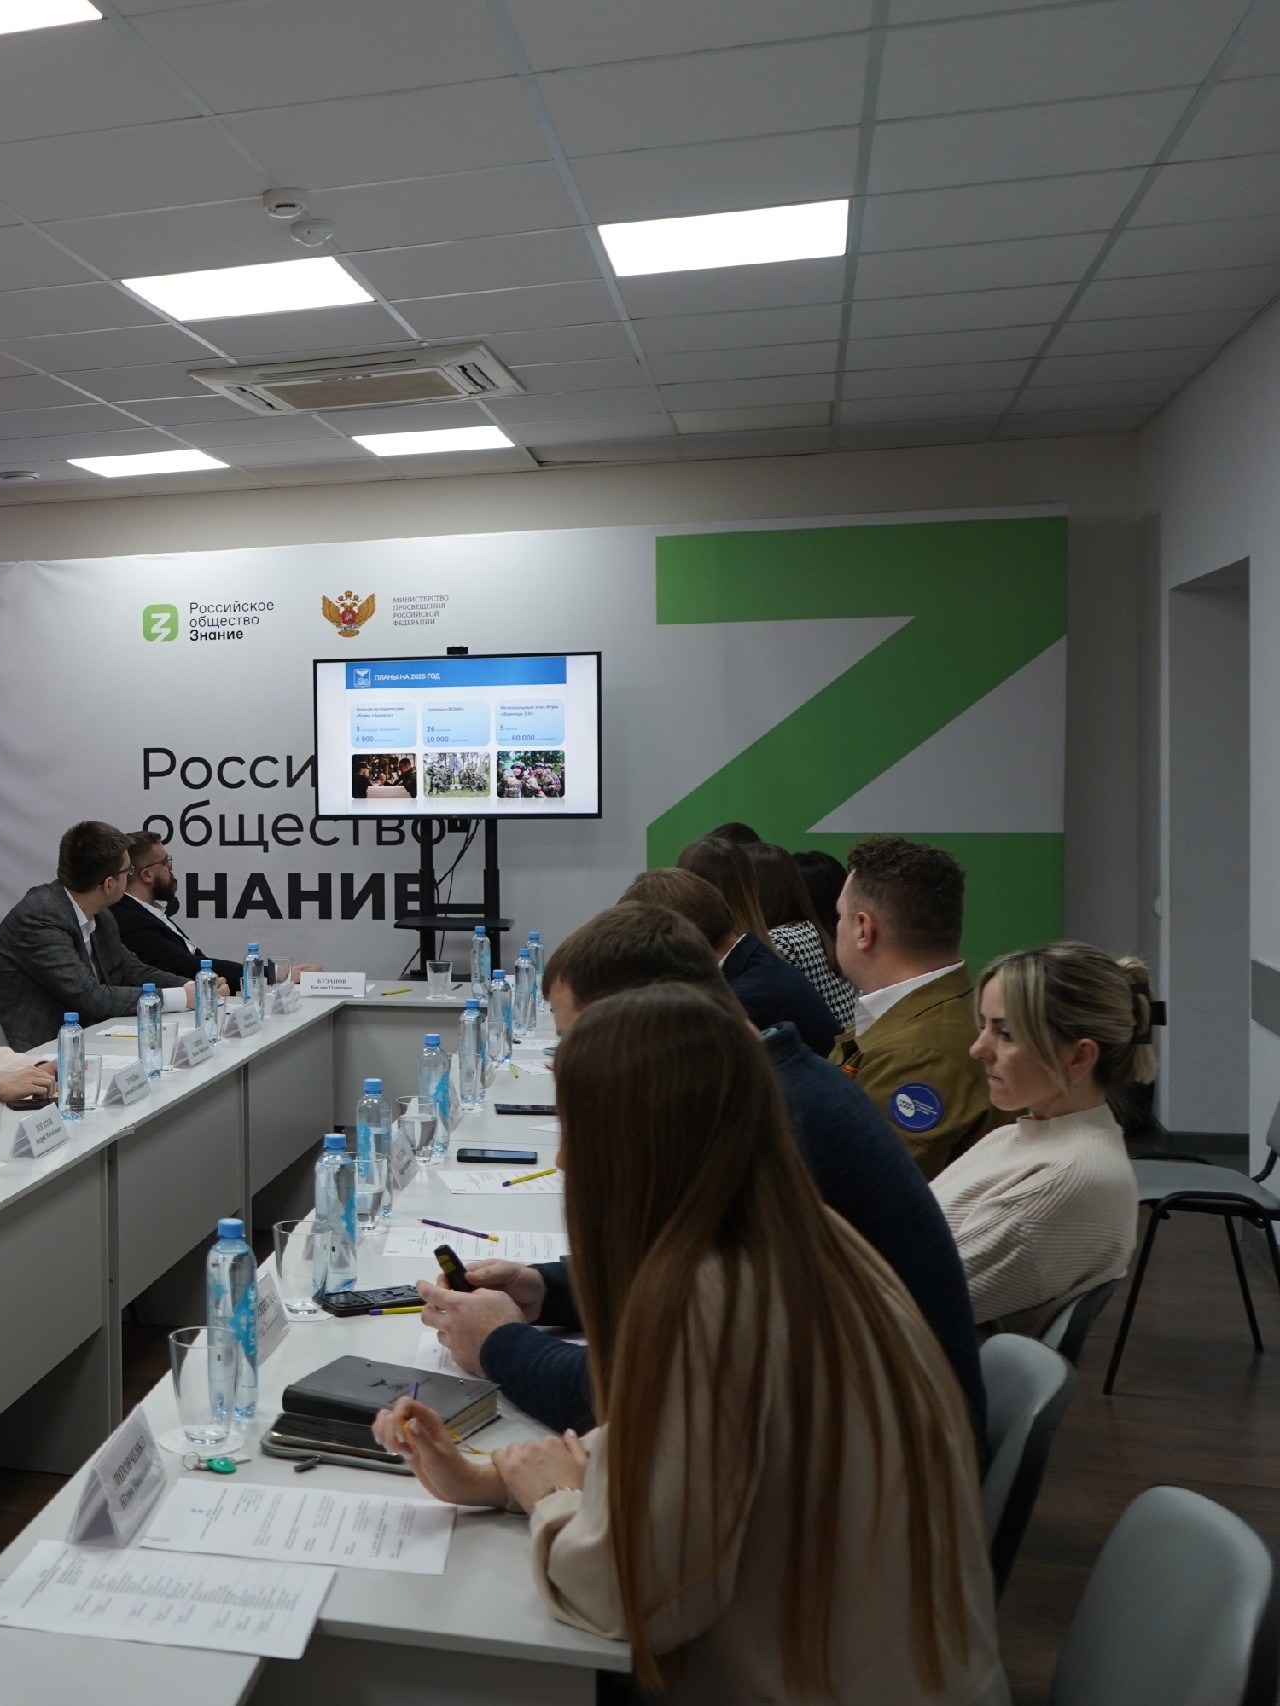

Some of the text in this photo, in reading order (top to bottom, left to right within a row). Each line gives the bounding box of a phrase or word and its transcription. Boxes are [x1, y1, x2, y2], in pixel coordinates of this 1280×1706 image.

[392, 594, 450, 603] МИНИСТЕРСТВО
[189, 600, 275, 615] Российское
[392, 602, 447, 612] ПРОСВЕЩЕНИЯ
[392, 610, 440, 619] РОССИЙСКОЙ
[189, 615, 260, 629] общество
[392, 618, 436, 627] ФЕДЕРАЦИИ
[189, 628, 243, 641] Знание
[427, 672, 440, 681] ГОД
[143, 747, 315, 790] Росси
[166, 872, 422, 921] НАНИЕ
